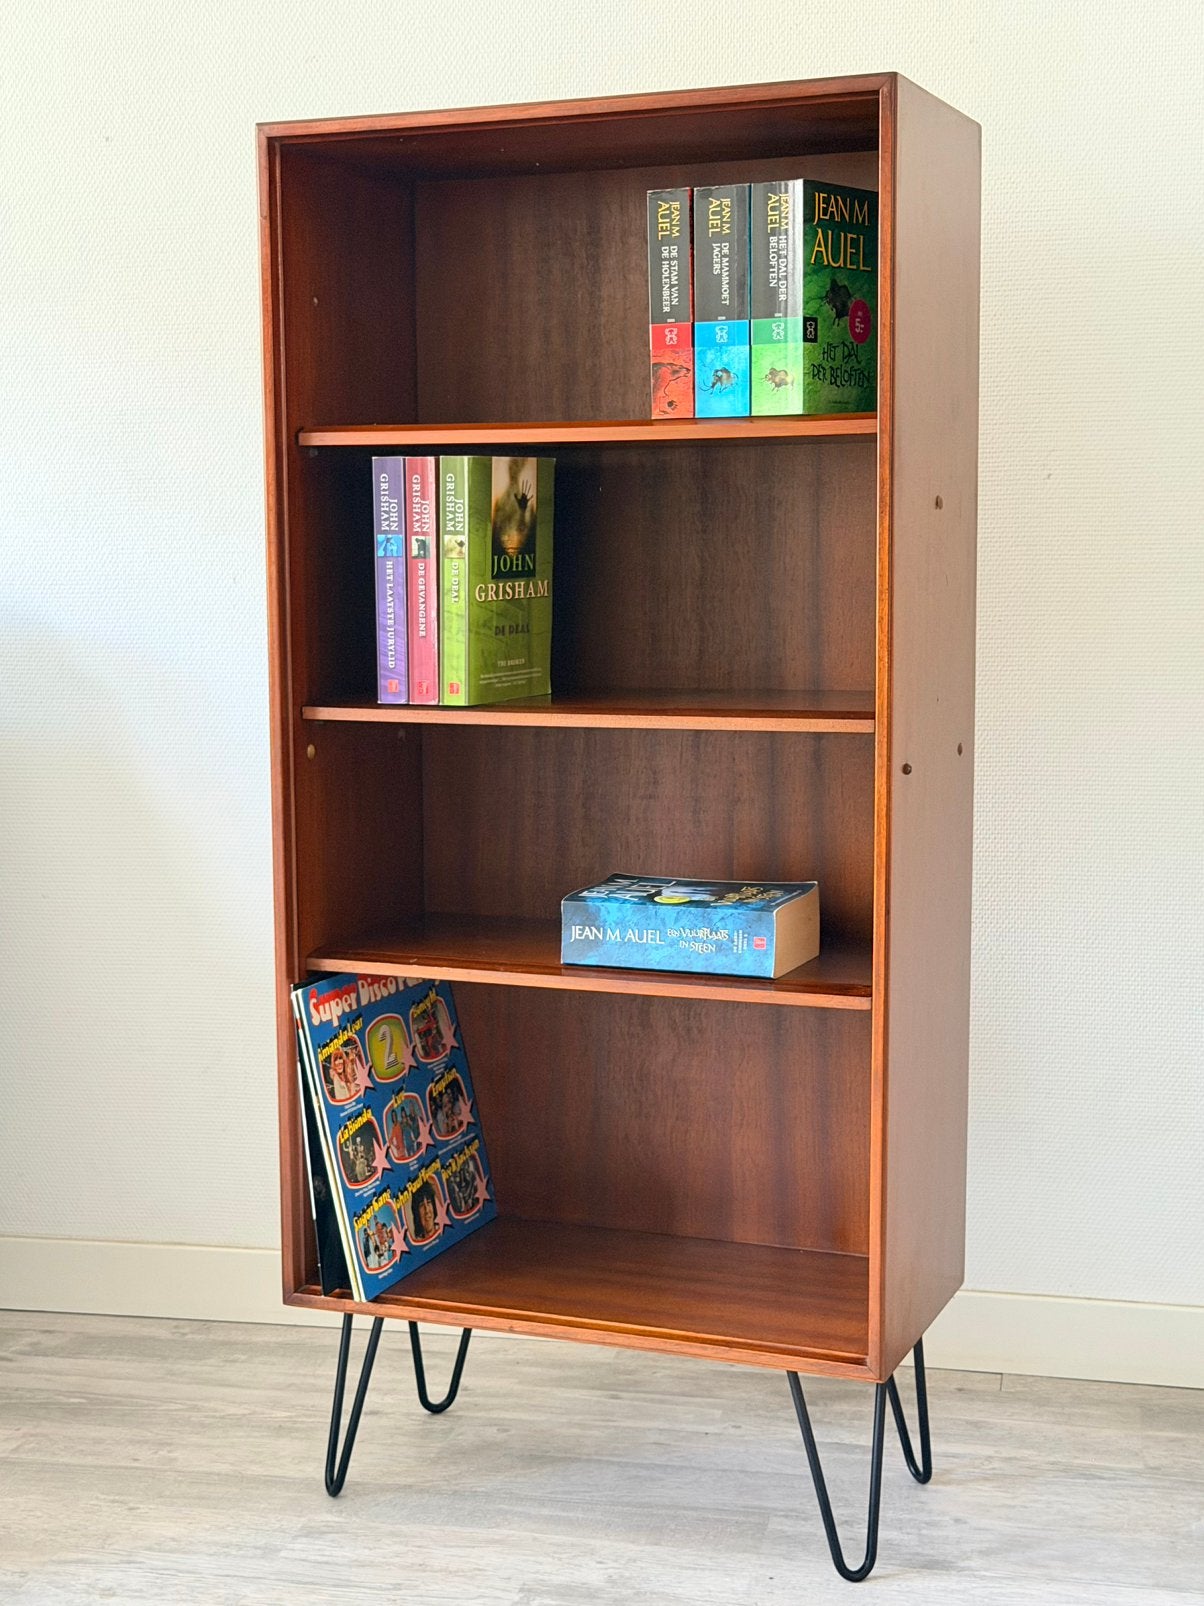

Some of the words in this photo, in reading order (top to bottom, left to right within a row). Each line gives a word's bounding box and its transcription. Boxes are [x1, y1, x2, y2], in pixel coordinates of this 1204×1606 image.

[669, 201, 680, 225] JEAN
[708, 198, 721, 238] AUEL
[720, 198, 731, 225] JEAN
[768, 193, 780, 233] AUEL
[779, 193, 789, 218] JEAN
[813, 191, 850, 225] JEAN
[658, 201, 670, 240] AUEL
[671, 226, 680, 237] M
[722, 226, 731, 235] M
[780, 218, 789, 230] M
[661, 246, 669, 258] DE
[670, 246, 678, 258] DE
[722, 242, 729, 255] DE
[779, 235, 787, 256] HET
[811, 228, 872, 272] AUEL
[712, 243, 720, 275] JAGERS
[769, 236, 777, 287] BELOFTEN
[779, 258, 787, 279] DAL
[670, 259, 679, 285] STAM
[722, 257, 730, 306] MAMMOET
[662, 261, 670, 313] HOLENBEER
[671, 286, 679, 305] VAN
[779, 281, 787, 301] DER
[822, 342, 839, 362] HET
[842, 341, 861, 364] DAL
[811, 363, 827, 383] DER
[829, 364, 871, 388] BELOFTEN
[380, 473, 389, 531] GRISHAM
[388, 498, 398, 531] JOHN
[412, 474, 421, 532] GRISHAM
[446, 473, 454, 531] GRISHAM
[420, 500, 429, 532] JOHN
[455, 499, 463, 531] JOHN
[386, 561, 394, 581] HET
[418, 563, 425, 576] DE
[451, 562, 458, 576] DE
[493, 553, 535, 576] JOHN
[451, 577, 459, 604] DEAL
[475, 580, 549, 602] GRISHAM
[386, 583, 395, 625] LAATSTE
[418, 578, 426, 637] GEVANGENE
[494, 625, 506, 636] DE
[509, 623, 530, 635] DEAL
[386, 627, 395, 669] JURYLID
[569, 925, 604, 943] JEAN
[606, 927, 621, 942] M
[624, 931, 665, 945] AUEL
[680, 927, 729, 940] VUURPLAATS
[680, 940, 688, 948] IN
[689, 941, 716, 954] STEEN
[309, 990, 358, 1027] Super
[357, 976, 398, 1007] Disco
[377, 1025, 400, 1070] 2
